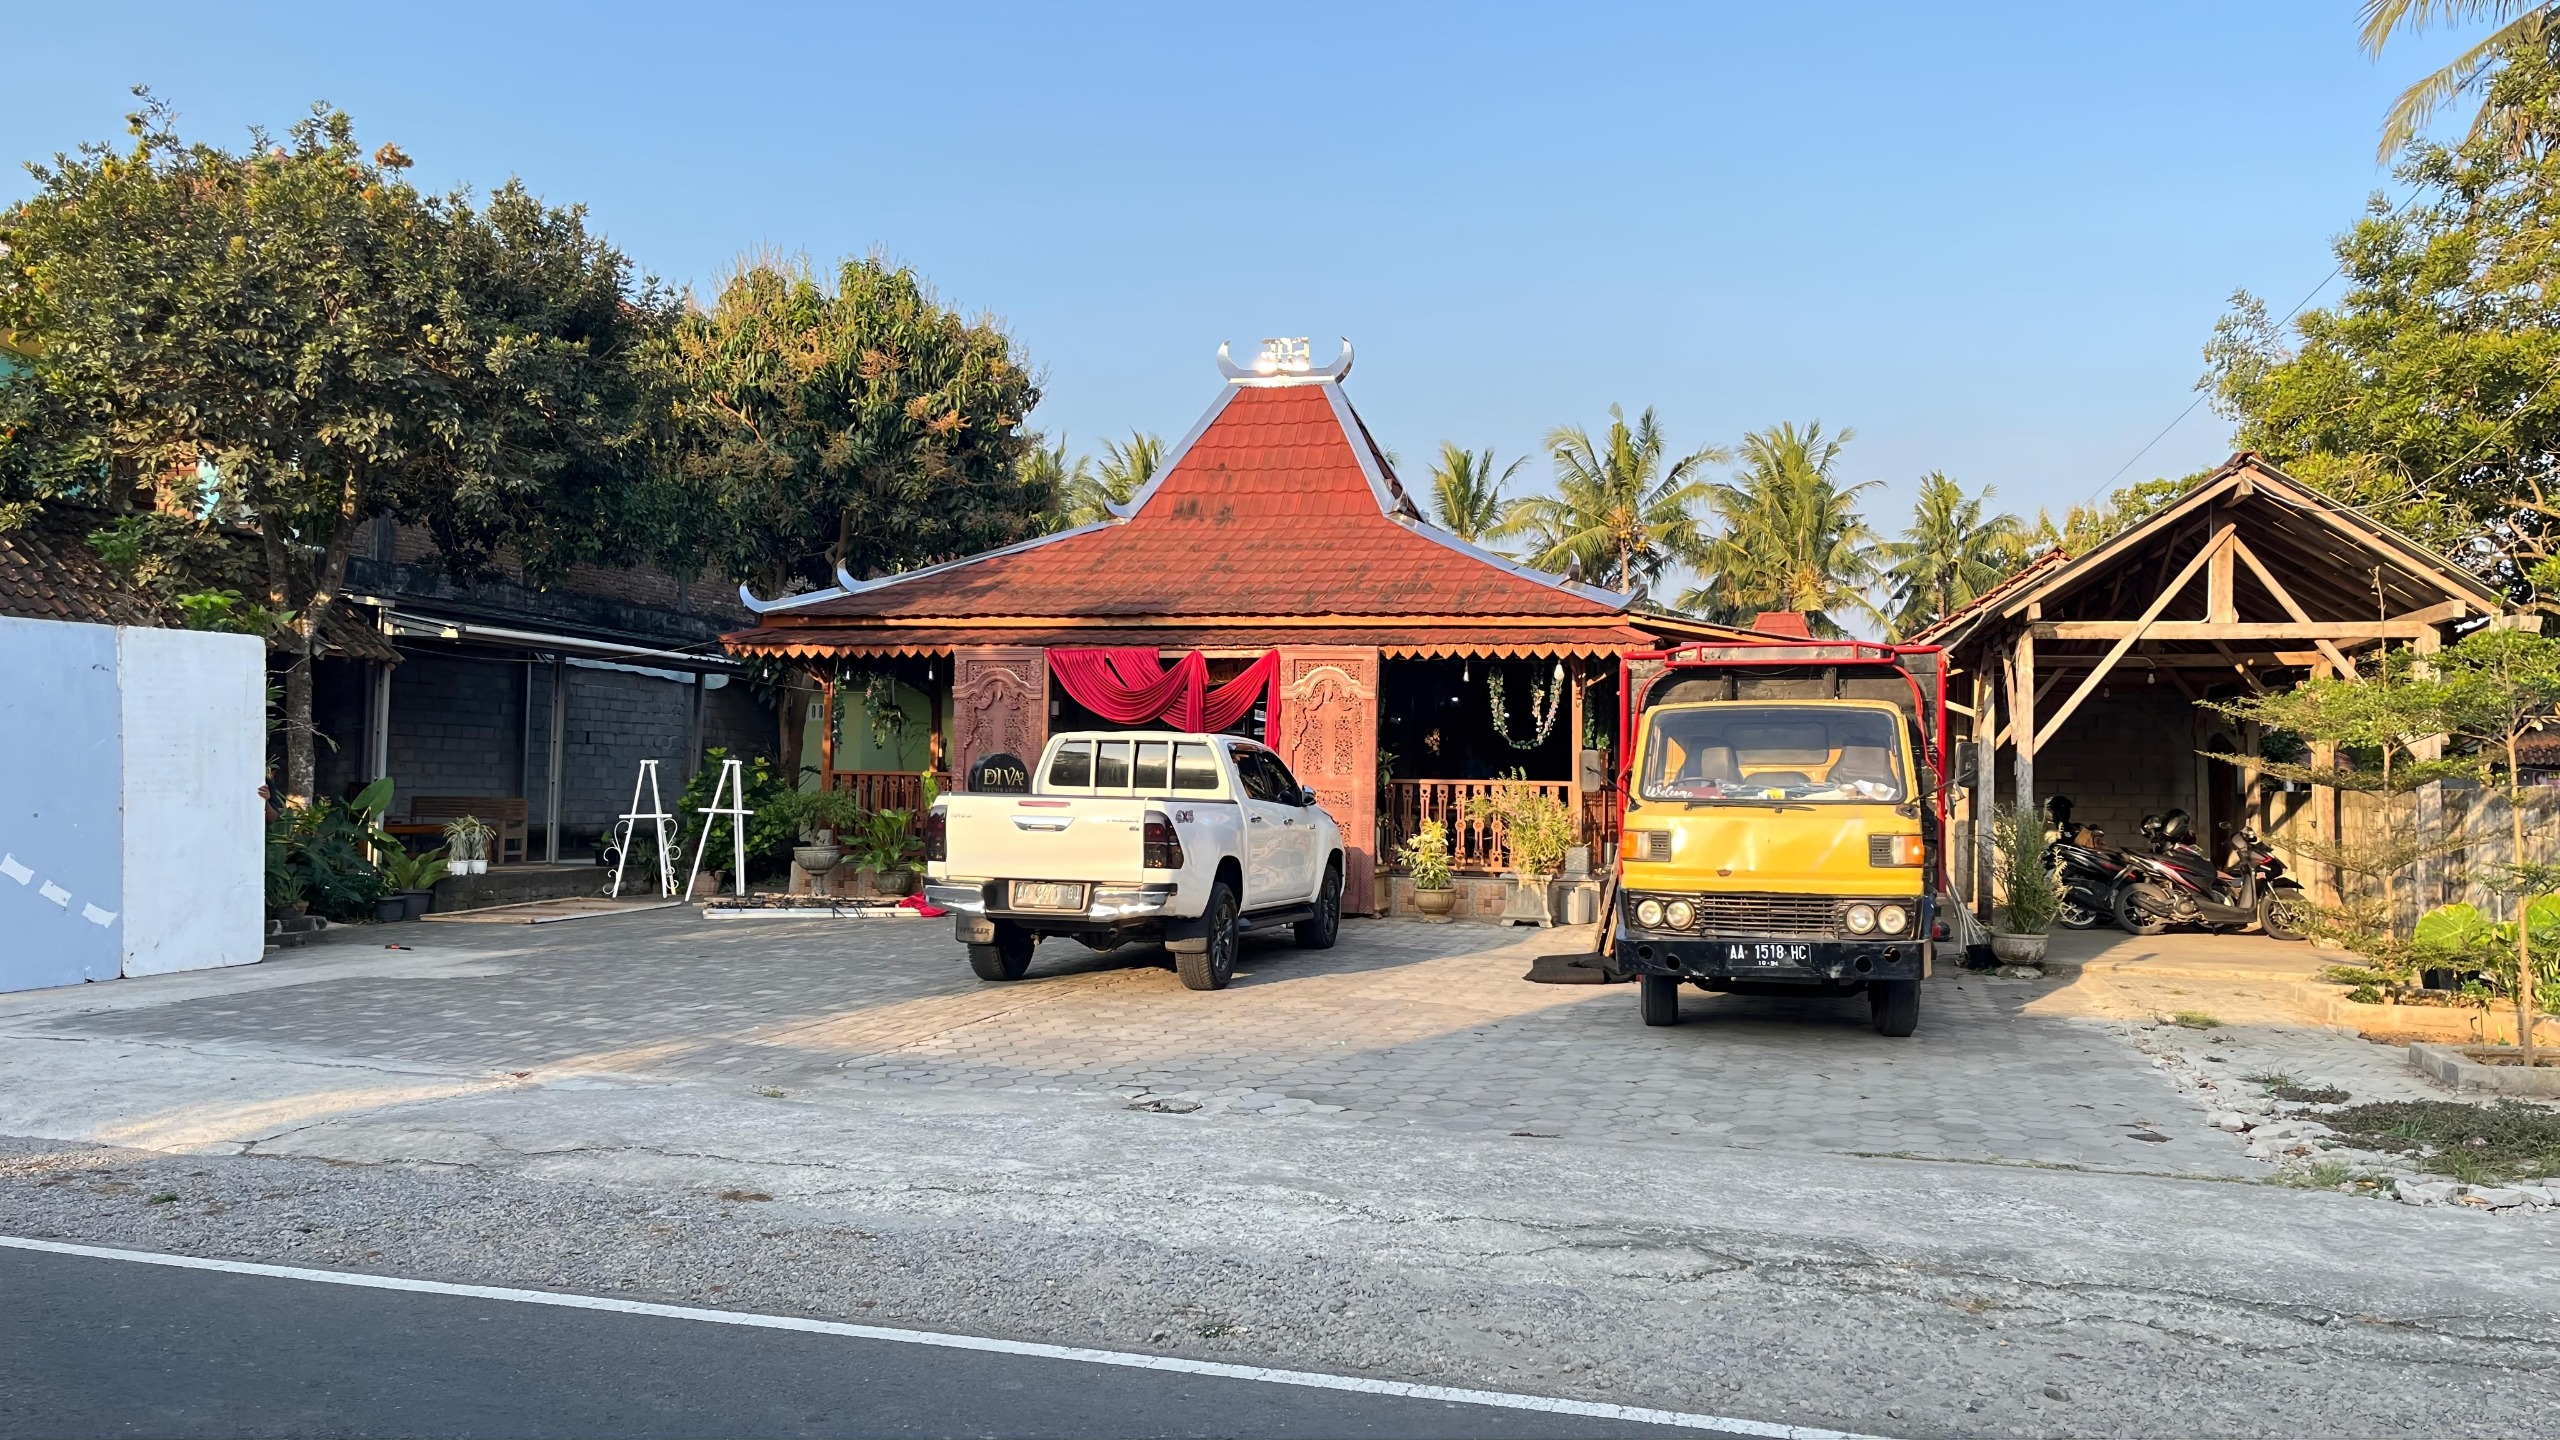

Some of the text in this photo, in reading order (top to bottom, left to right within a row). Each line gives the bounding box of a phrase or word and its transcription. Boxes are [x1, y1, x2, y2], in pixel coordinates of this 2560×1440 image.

[1645, 784, 1694, 798] Welcome
[1730, 944, 1807, 960] AA 1518 HC
